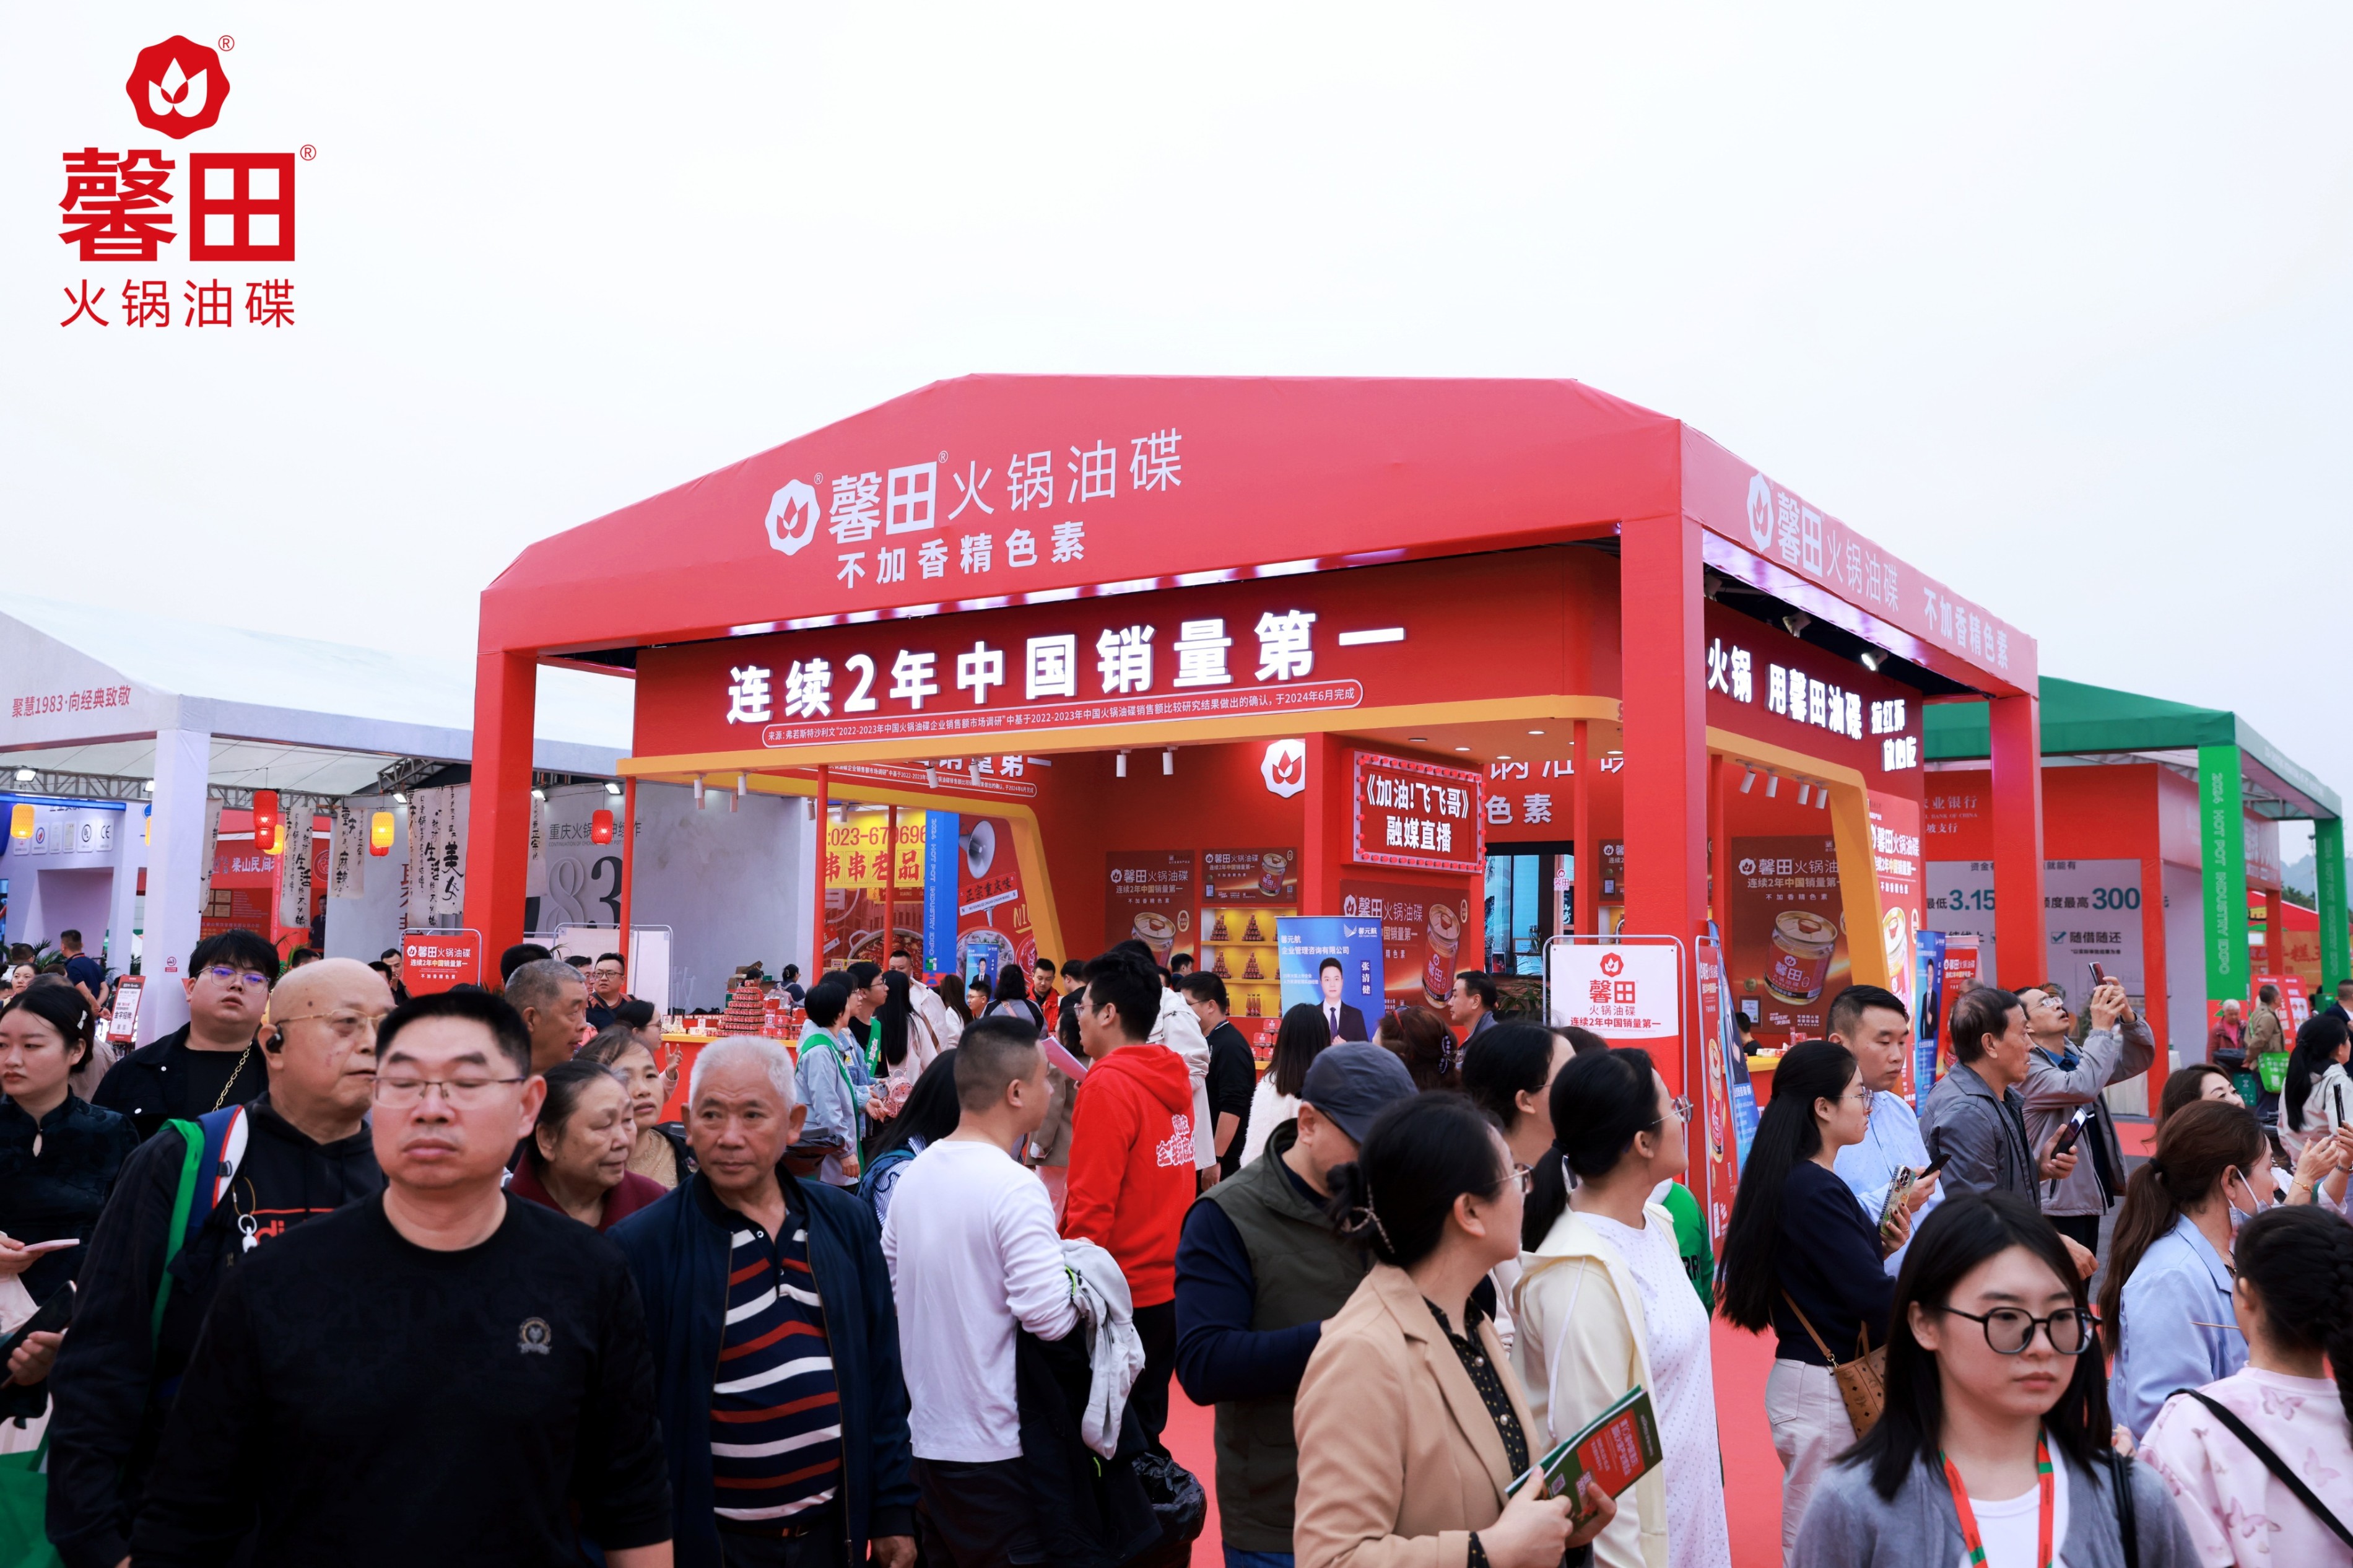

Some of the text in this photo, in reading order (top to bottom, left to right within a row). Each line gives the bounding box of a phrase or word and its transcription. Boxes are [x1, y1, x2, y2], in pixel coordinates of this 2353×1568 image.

[837, 521, 1085, 589] 不加香精色素
[1924, 586, 2009, 670] 不加香精色素
[726, 609, 1406, 725] 连续2年中国销量第一
[12, 684, 131, 718] 聚慧1983·向经典致敬
[1485, 793, 1552, 824] 色素
[1386, 815, 1452, 853] 融媒直播
[1925, 823, 1957, 834] 坡支行
[2213, 809, 2225, 837] HOT
[2214, 840, 2226, 866] POT
[2043, 861, 2076, 870] 就能有
[1116, 884, 1183, 894] 连续2年中国销量第一
[2216, 872, 2229, 937] INDUSTRY
[1383, 926, 1417, 941] 国销量第一
[2070, 931, 2121, 943] 随借随还
[1282, 946, 1349, 955] 企业管理咨询有限公司
[2218, 939, 2230, 975] EXPO
[411, 959, 468, 967] 连续2年中国销量第一
[1590, 980, 1635, 1003] 馨田
[1590, 1005, 1635, 1016] 火锅油碟
[1570, 1017, 1661, 1029] 连续2年中国销量第一
